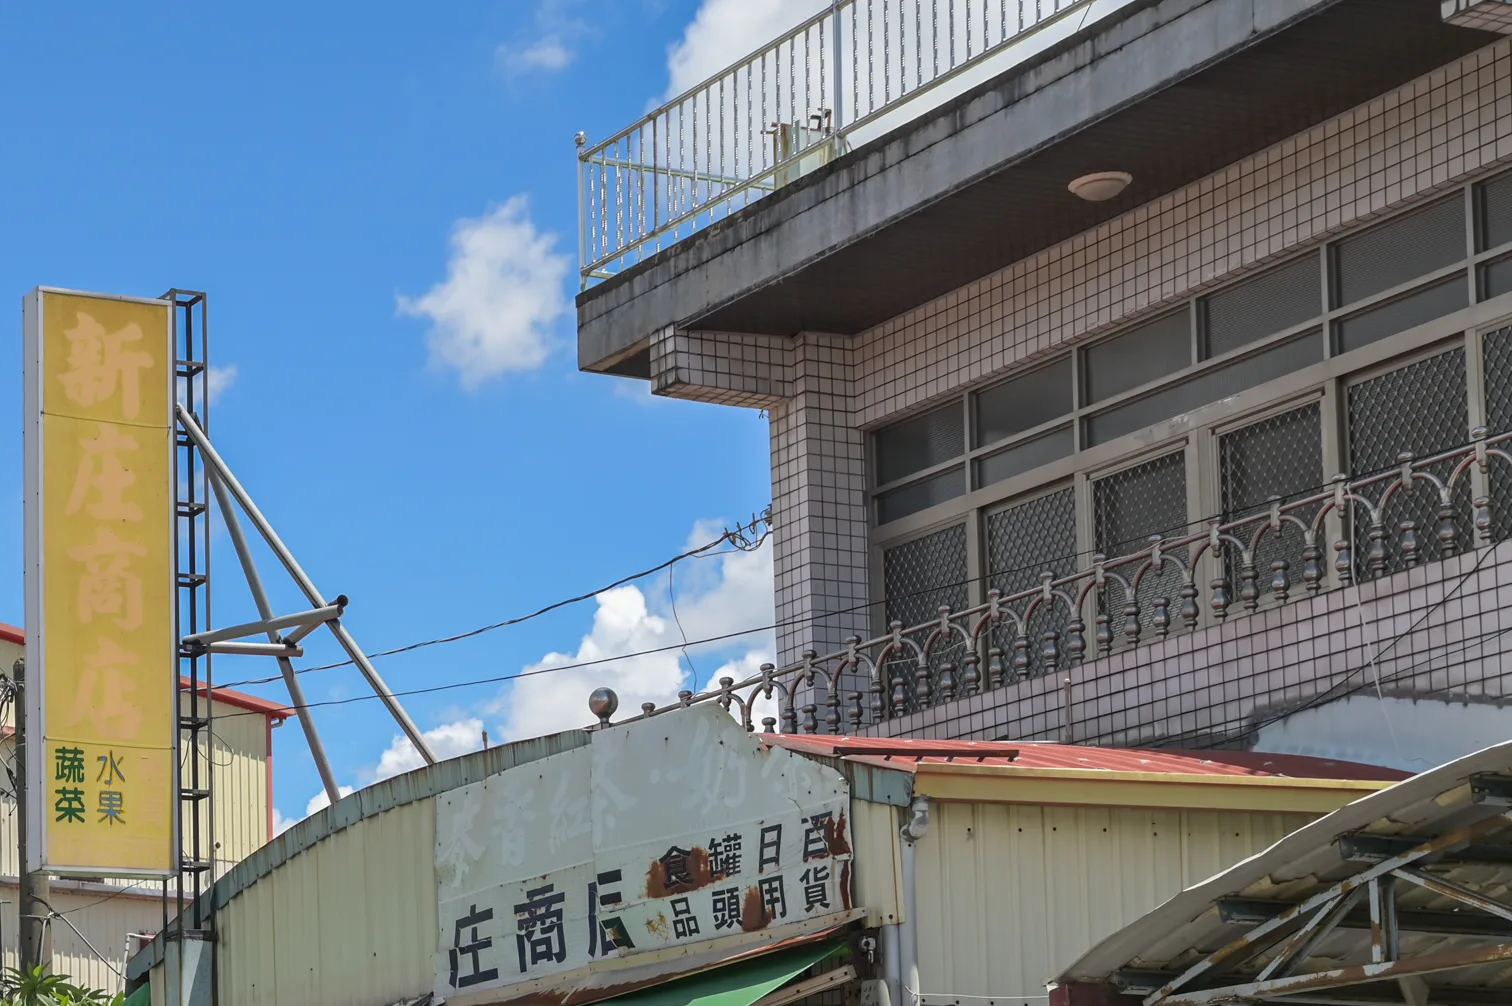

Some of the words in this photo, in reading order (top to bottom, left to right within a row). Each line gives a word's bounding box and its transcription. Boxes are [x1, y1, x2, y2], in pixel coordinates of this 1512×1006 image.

[57, 311, 154, 741] 新庄商店
[54, 746, 86, 825] 蔬菜
[96, 749, 126, 827] 水果
